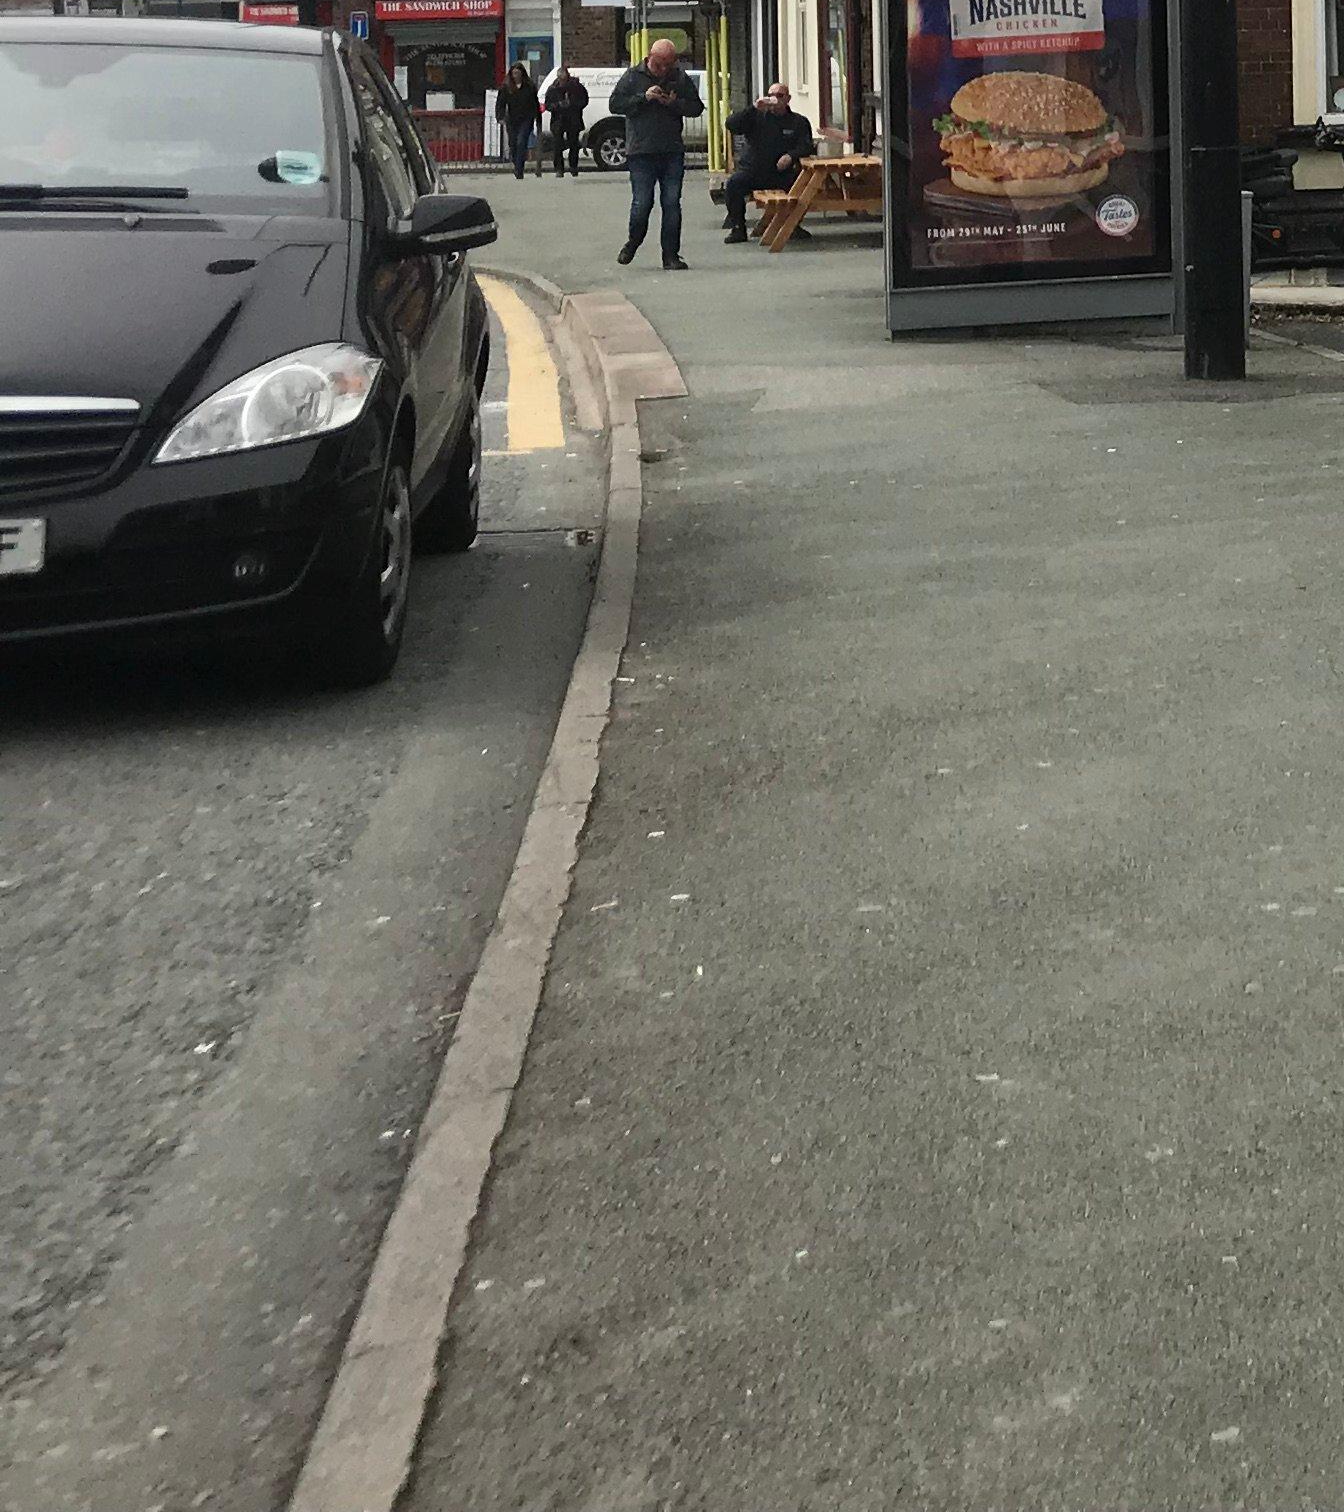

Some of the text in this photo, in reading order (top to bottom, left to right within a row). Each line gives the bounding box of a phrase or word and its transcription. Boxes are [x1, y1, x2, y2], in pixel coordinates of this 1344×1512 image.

[382, 0, 493, 12] THE SANDWICH SHOP
[996, 18, 1059, 32] CHICKEN
[976, 37, 1080, 52] WITH A SPICY KETCHUP
[927, 227, 955, 239] FROM
[958, 226, 980, 238] 29TH
[983, 225, 1004, 237] MAY
[1040, 222, 1067, 234] JUNE
